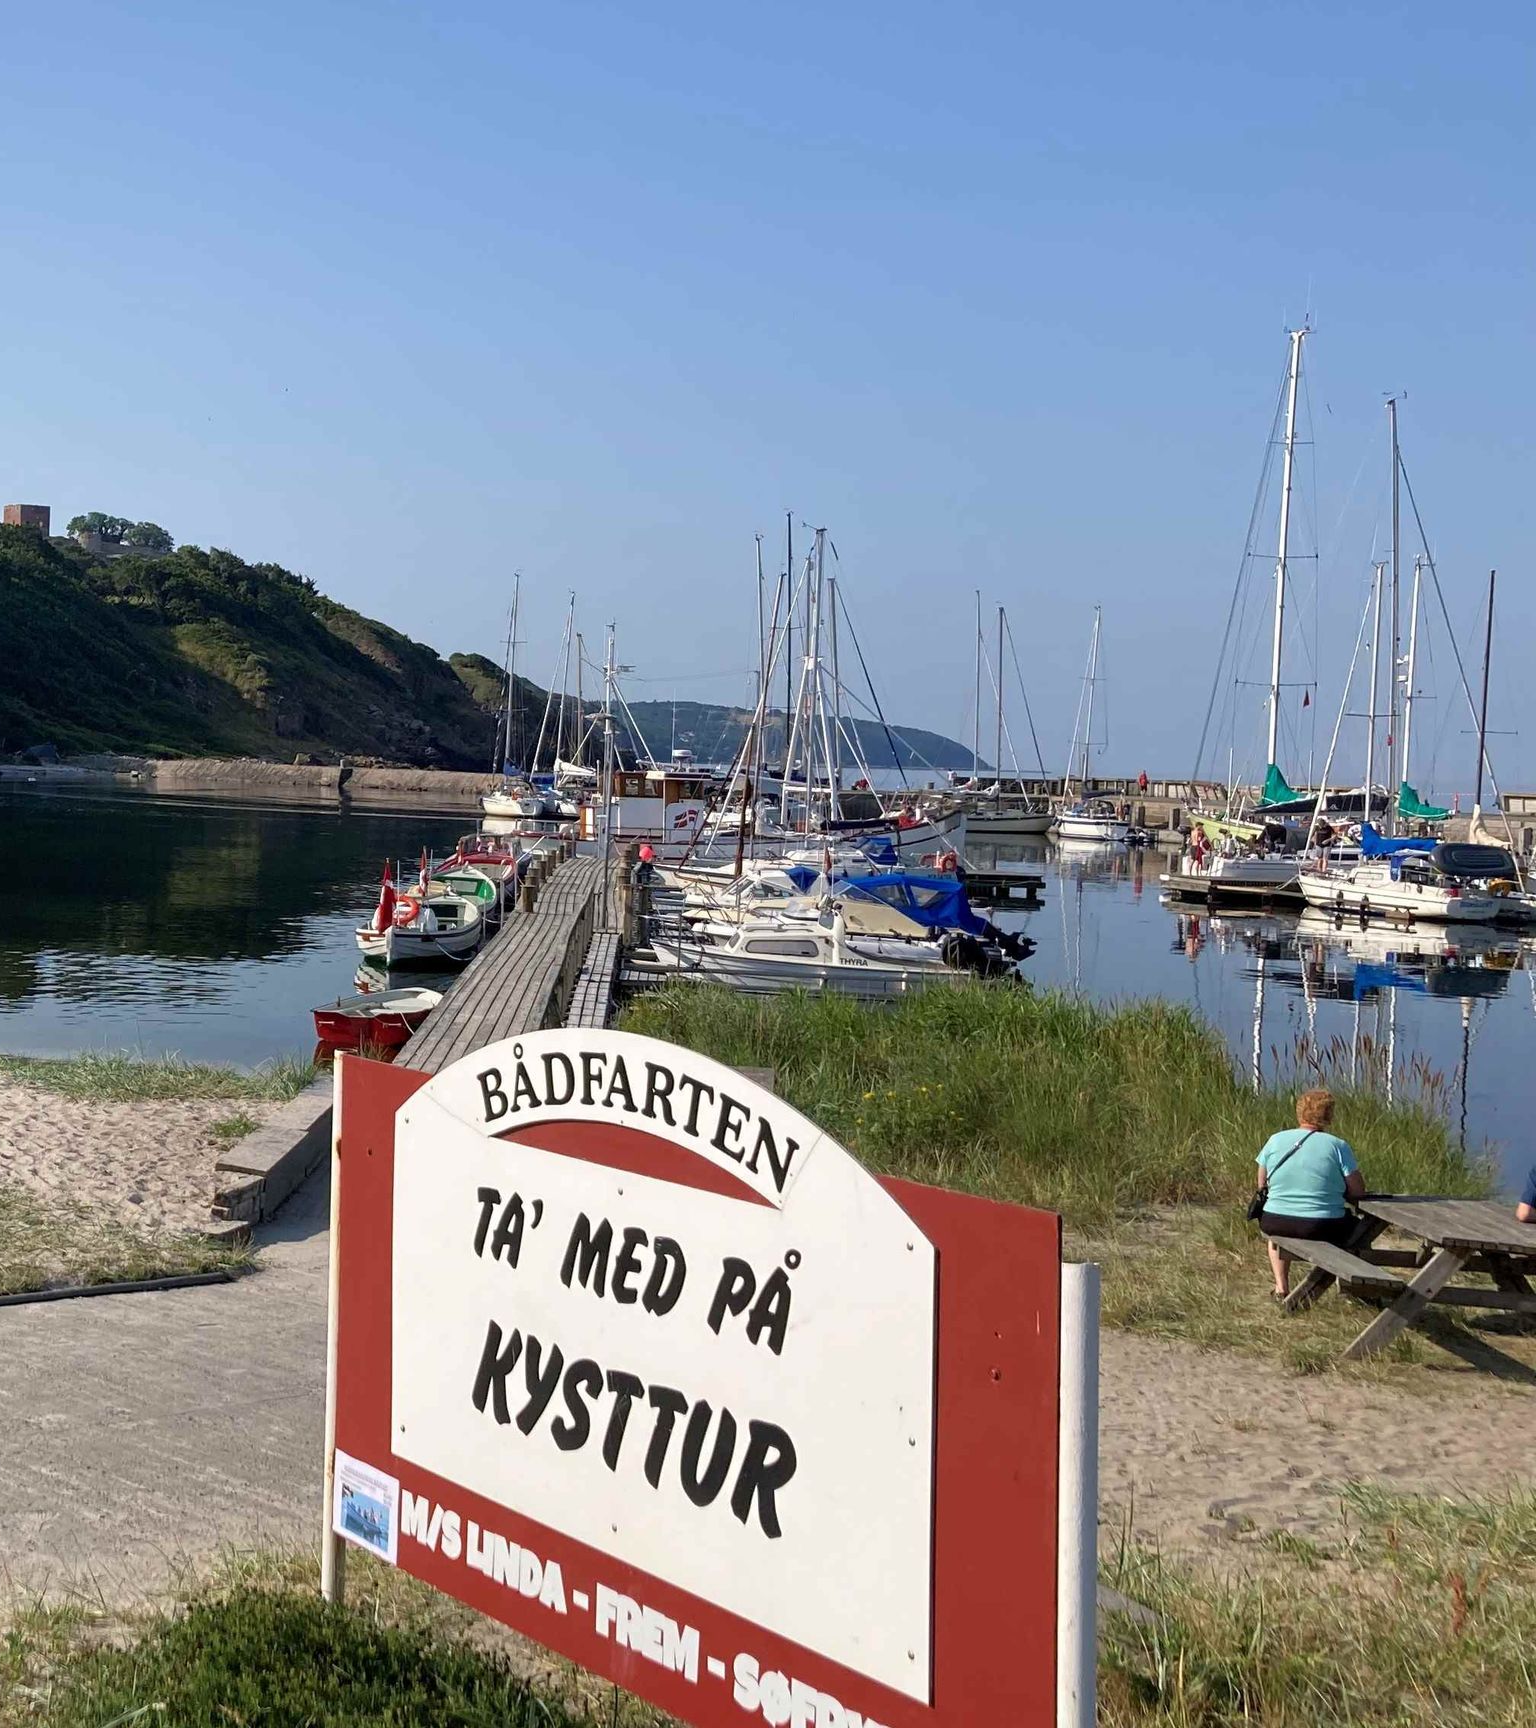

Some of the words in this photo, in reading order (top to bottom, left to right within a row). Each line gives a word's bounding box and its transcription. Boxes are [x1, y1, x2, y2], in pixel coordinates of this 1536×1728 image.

[839, 957, 869, 967] THYRA
[476, 1042, 800, 1194] BÅDFARTEN
[560, 1212, 687, 1317] MED
[707, 1249, 802, 1356] PÅ
[472, 1320, 798, 1539] KYSTTUR
[401, 1489, 462, 1561] M/S
[467, 1520, 567, 1615] LINDA
[595, 1582, 701, 1683] FREM
